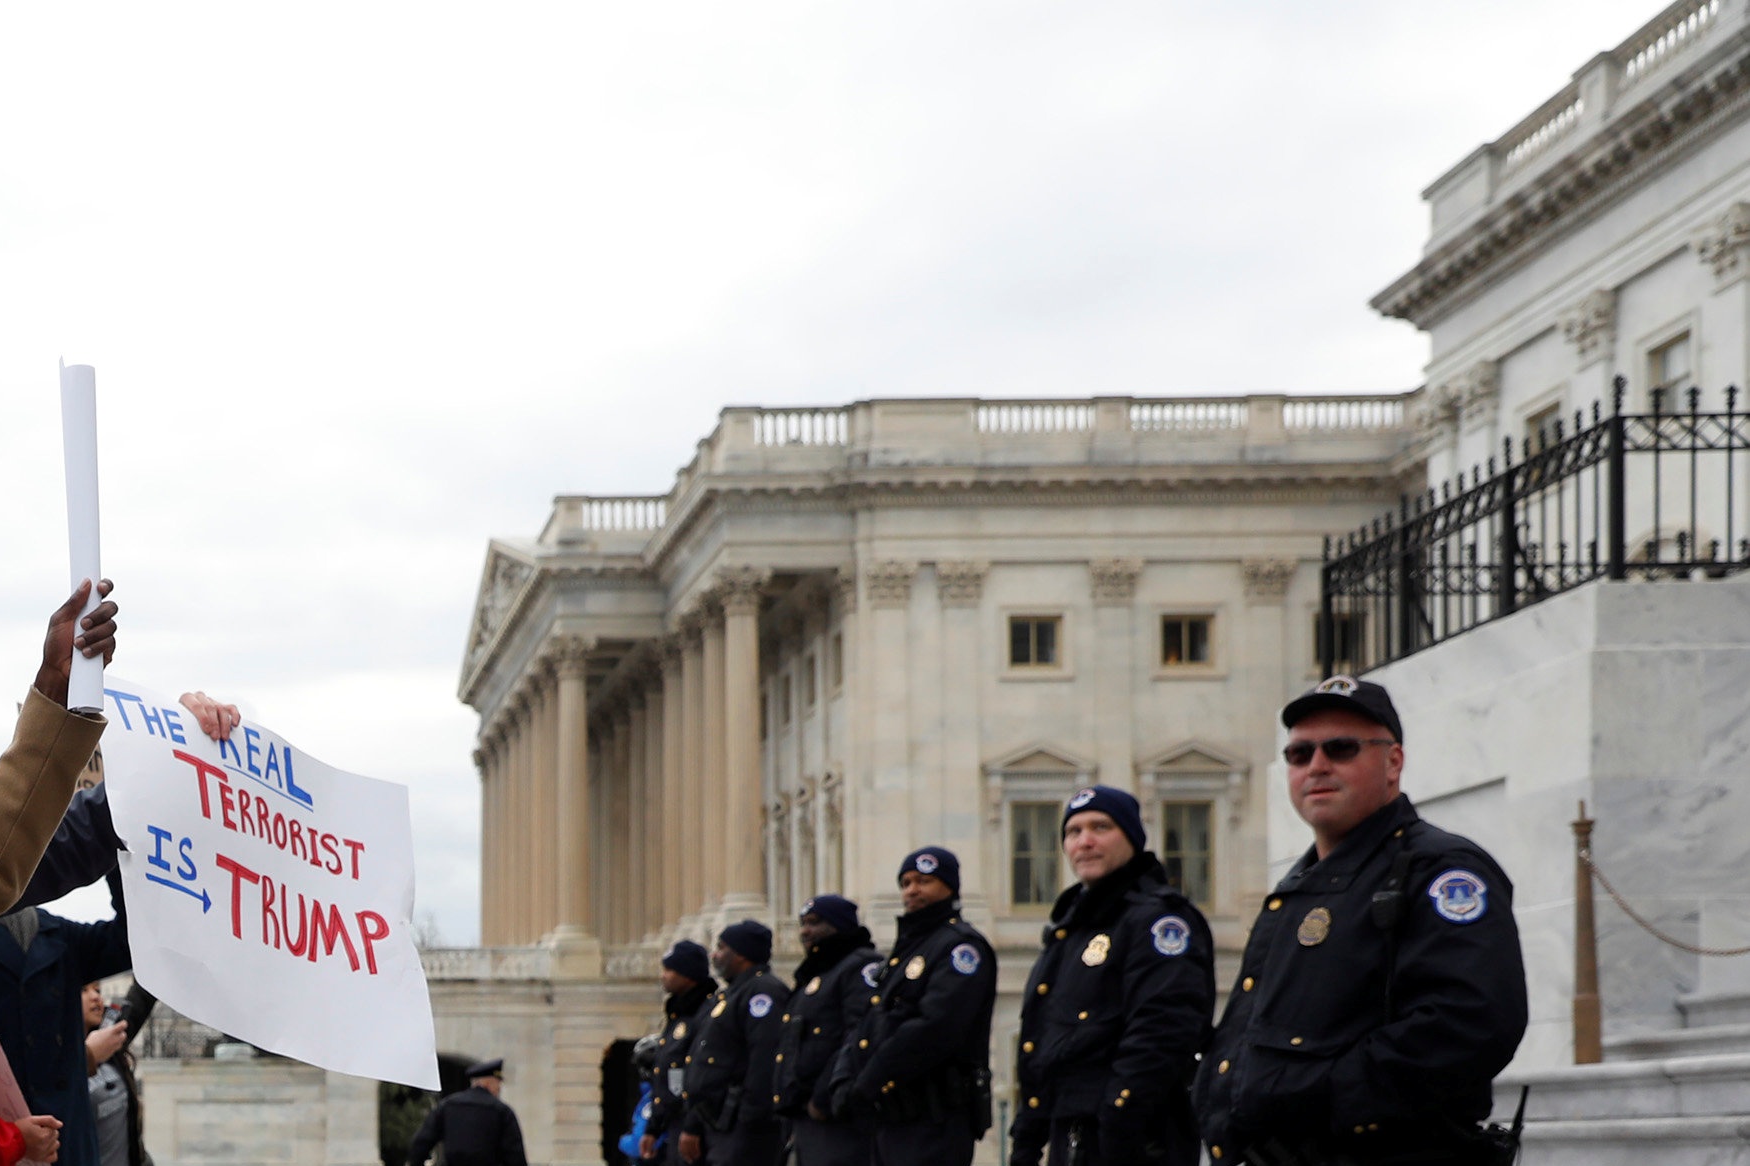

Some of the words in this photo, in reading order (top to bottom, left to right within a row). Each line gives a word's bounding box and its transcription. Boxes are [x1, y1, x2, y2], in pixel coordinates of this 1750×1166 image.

[103, 688, 186, 745] THE
[173, 749, 365, 880] TERRORIST
[147, 825, 197, 881] IS
[216, 853, 390, 975] TRUMP
